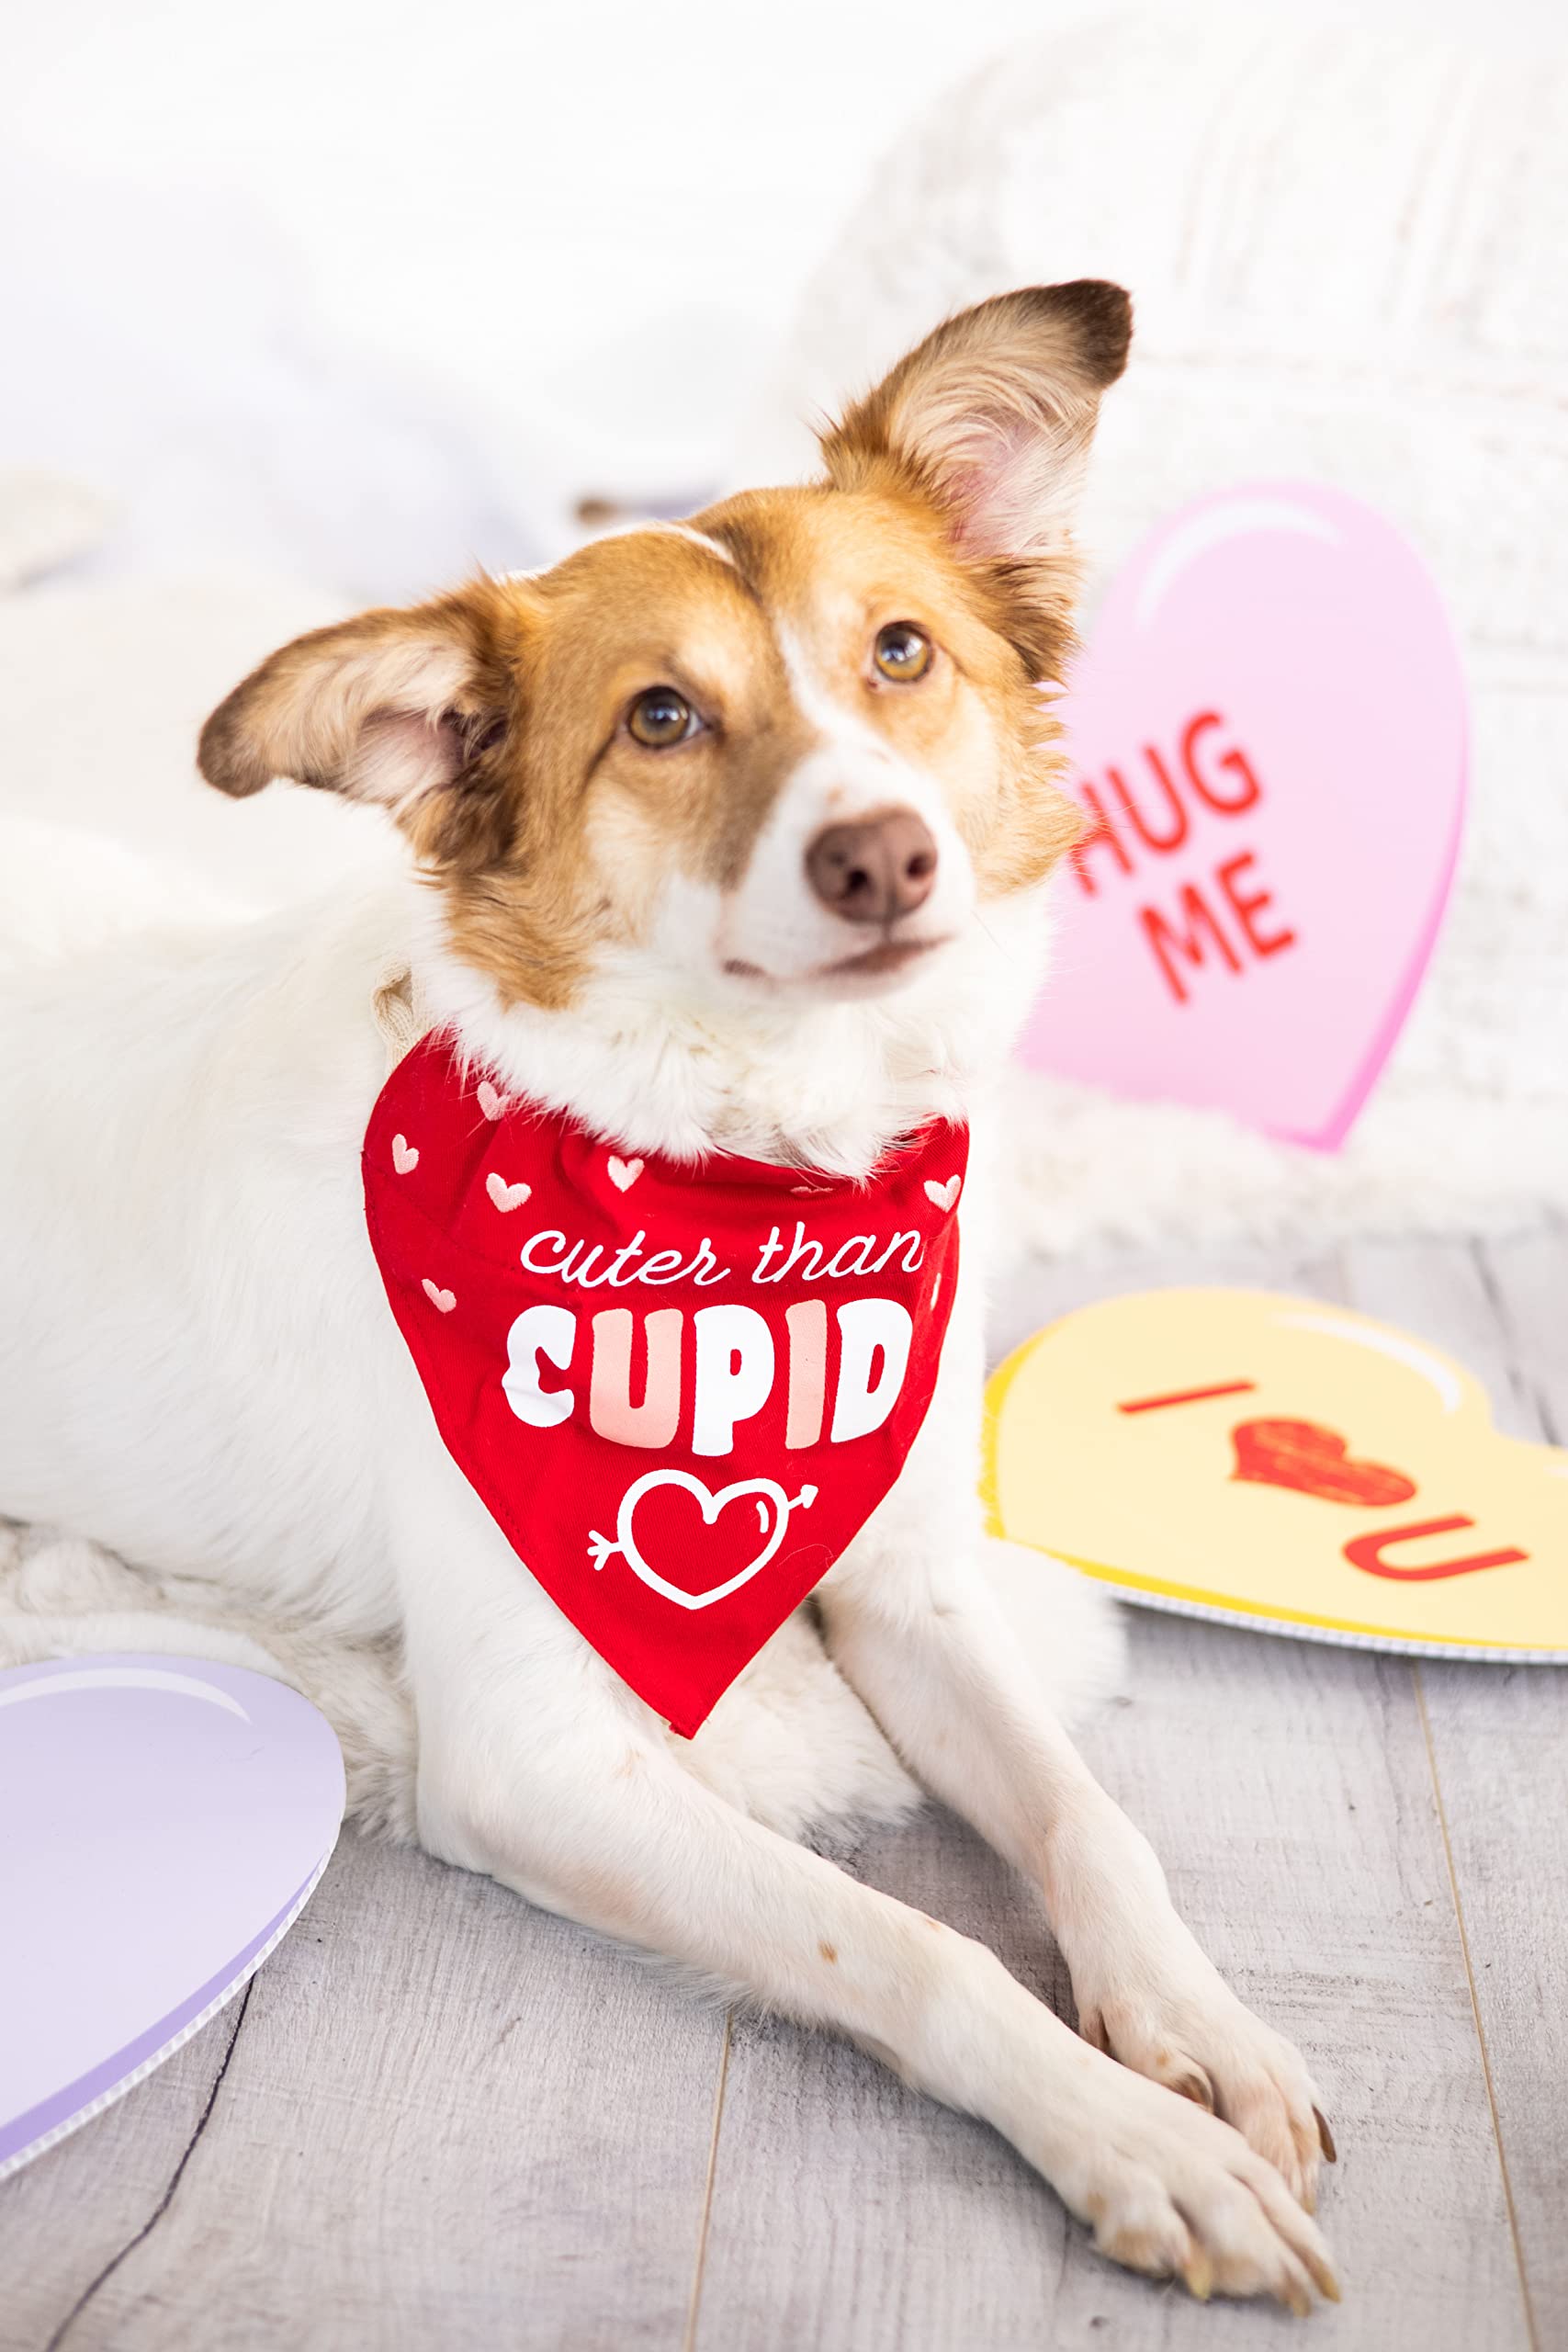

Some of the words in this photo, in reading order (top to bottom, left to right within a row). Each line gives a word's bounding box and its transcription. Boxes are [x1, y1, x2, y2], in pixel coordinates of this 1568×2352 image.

[1068, 707, 1261, 896] HUG
[1141, 850, 1295, 1005] ME
[519, 1229, 732, 1288] cuter
[742, 1221, 923, 1284] than
[501, 1297, 914, 1457] CUPID
[1117, 1378, 1257, 1416] I
[1342, 1513, 1530, 1581] U
